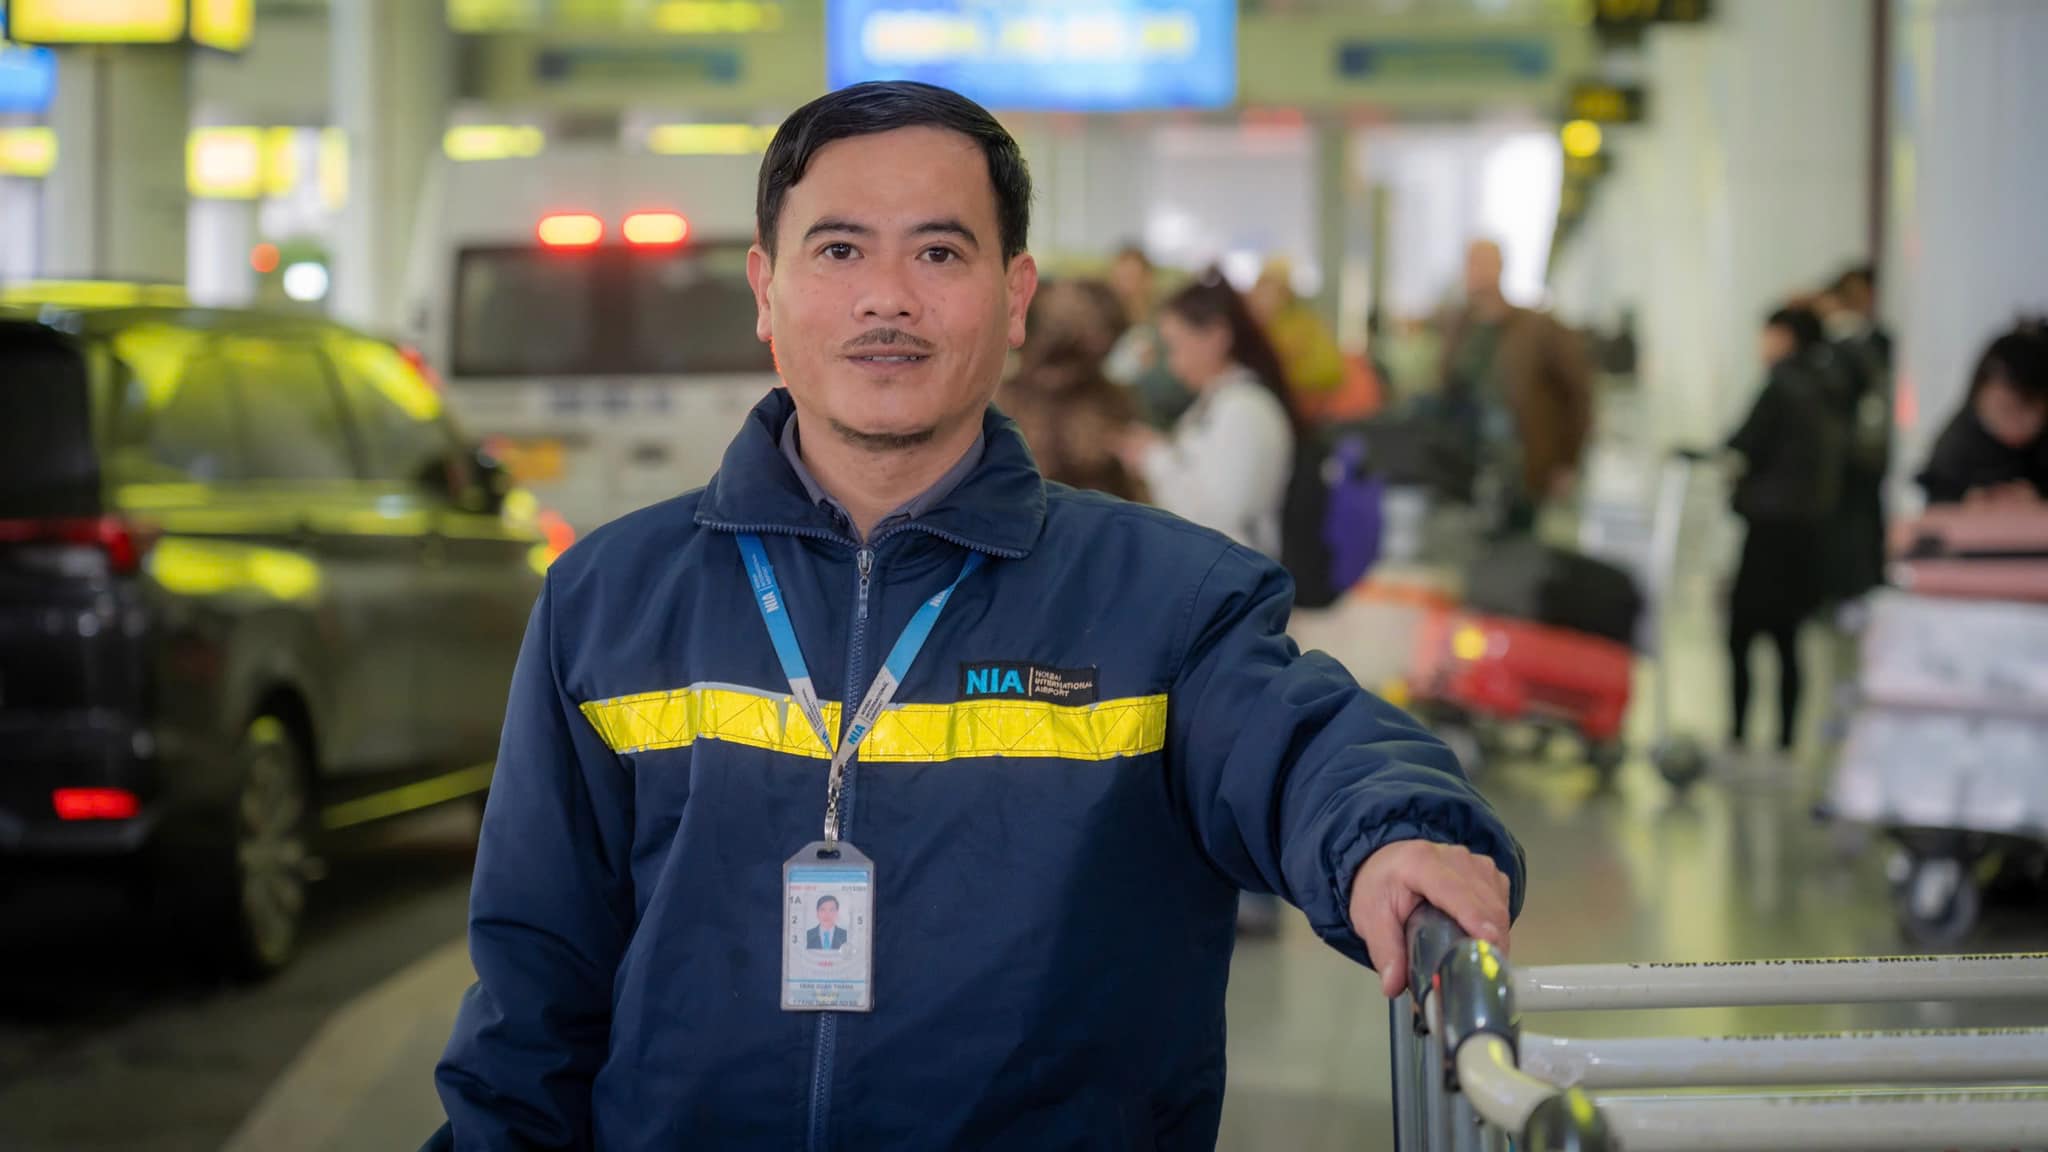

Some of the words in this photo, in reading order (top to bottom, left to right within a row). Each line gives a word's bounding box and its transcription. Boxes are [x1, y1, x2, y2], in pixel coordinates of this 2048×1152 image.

[762, 591, 779, 614] NIA
[966, 667, 1025, 695] NIA
[1034, 677, 1093, 691] INTERNATIONAL
[1034, 687, 1070, 697] AIRPORT
[847, 723, 867, 746] NIA
[791, 914, 798, 925] 2
[791, 934, 798, 945] 3
[1649, 961, 1698, 969] PUSH
[1702, 959, 1757, 968] DOWN
[1764, 959, 1786, 967] TO
[1792, 957, 1869, 965] RELEASE
